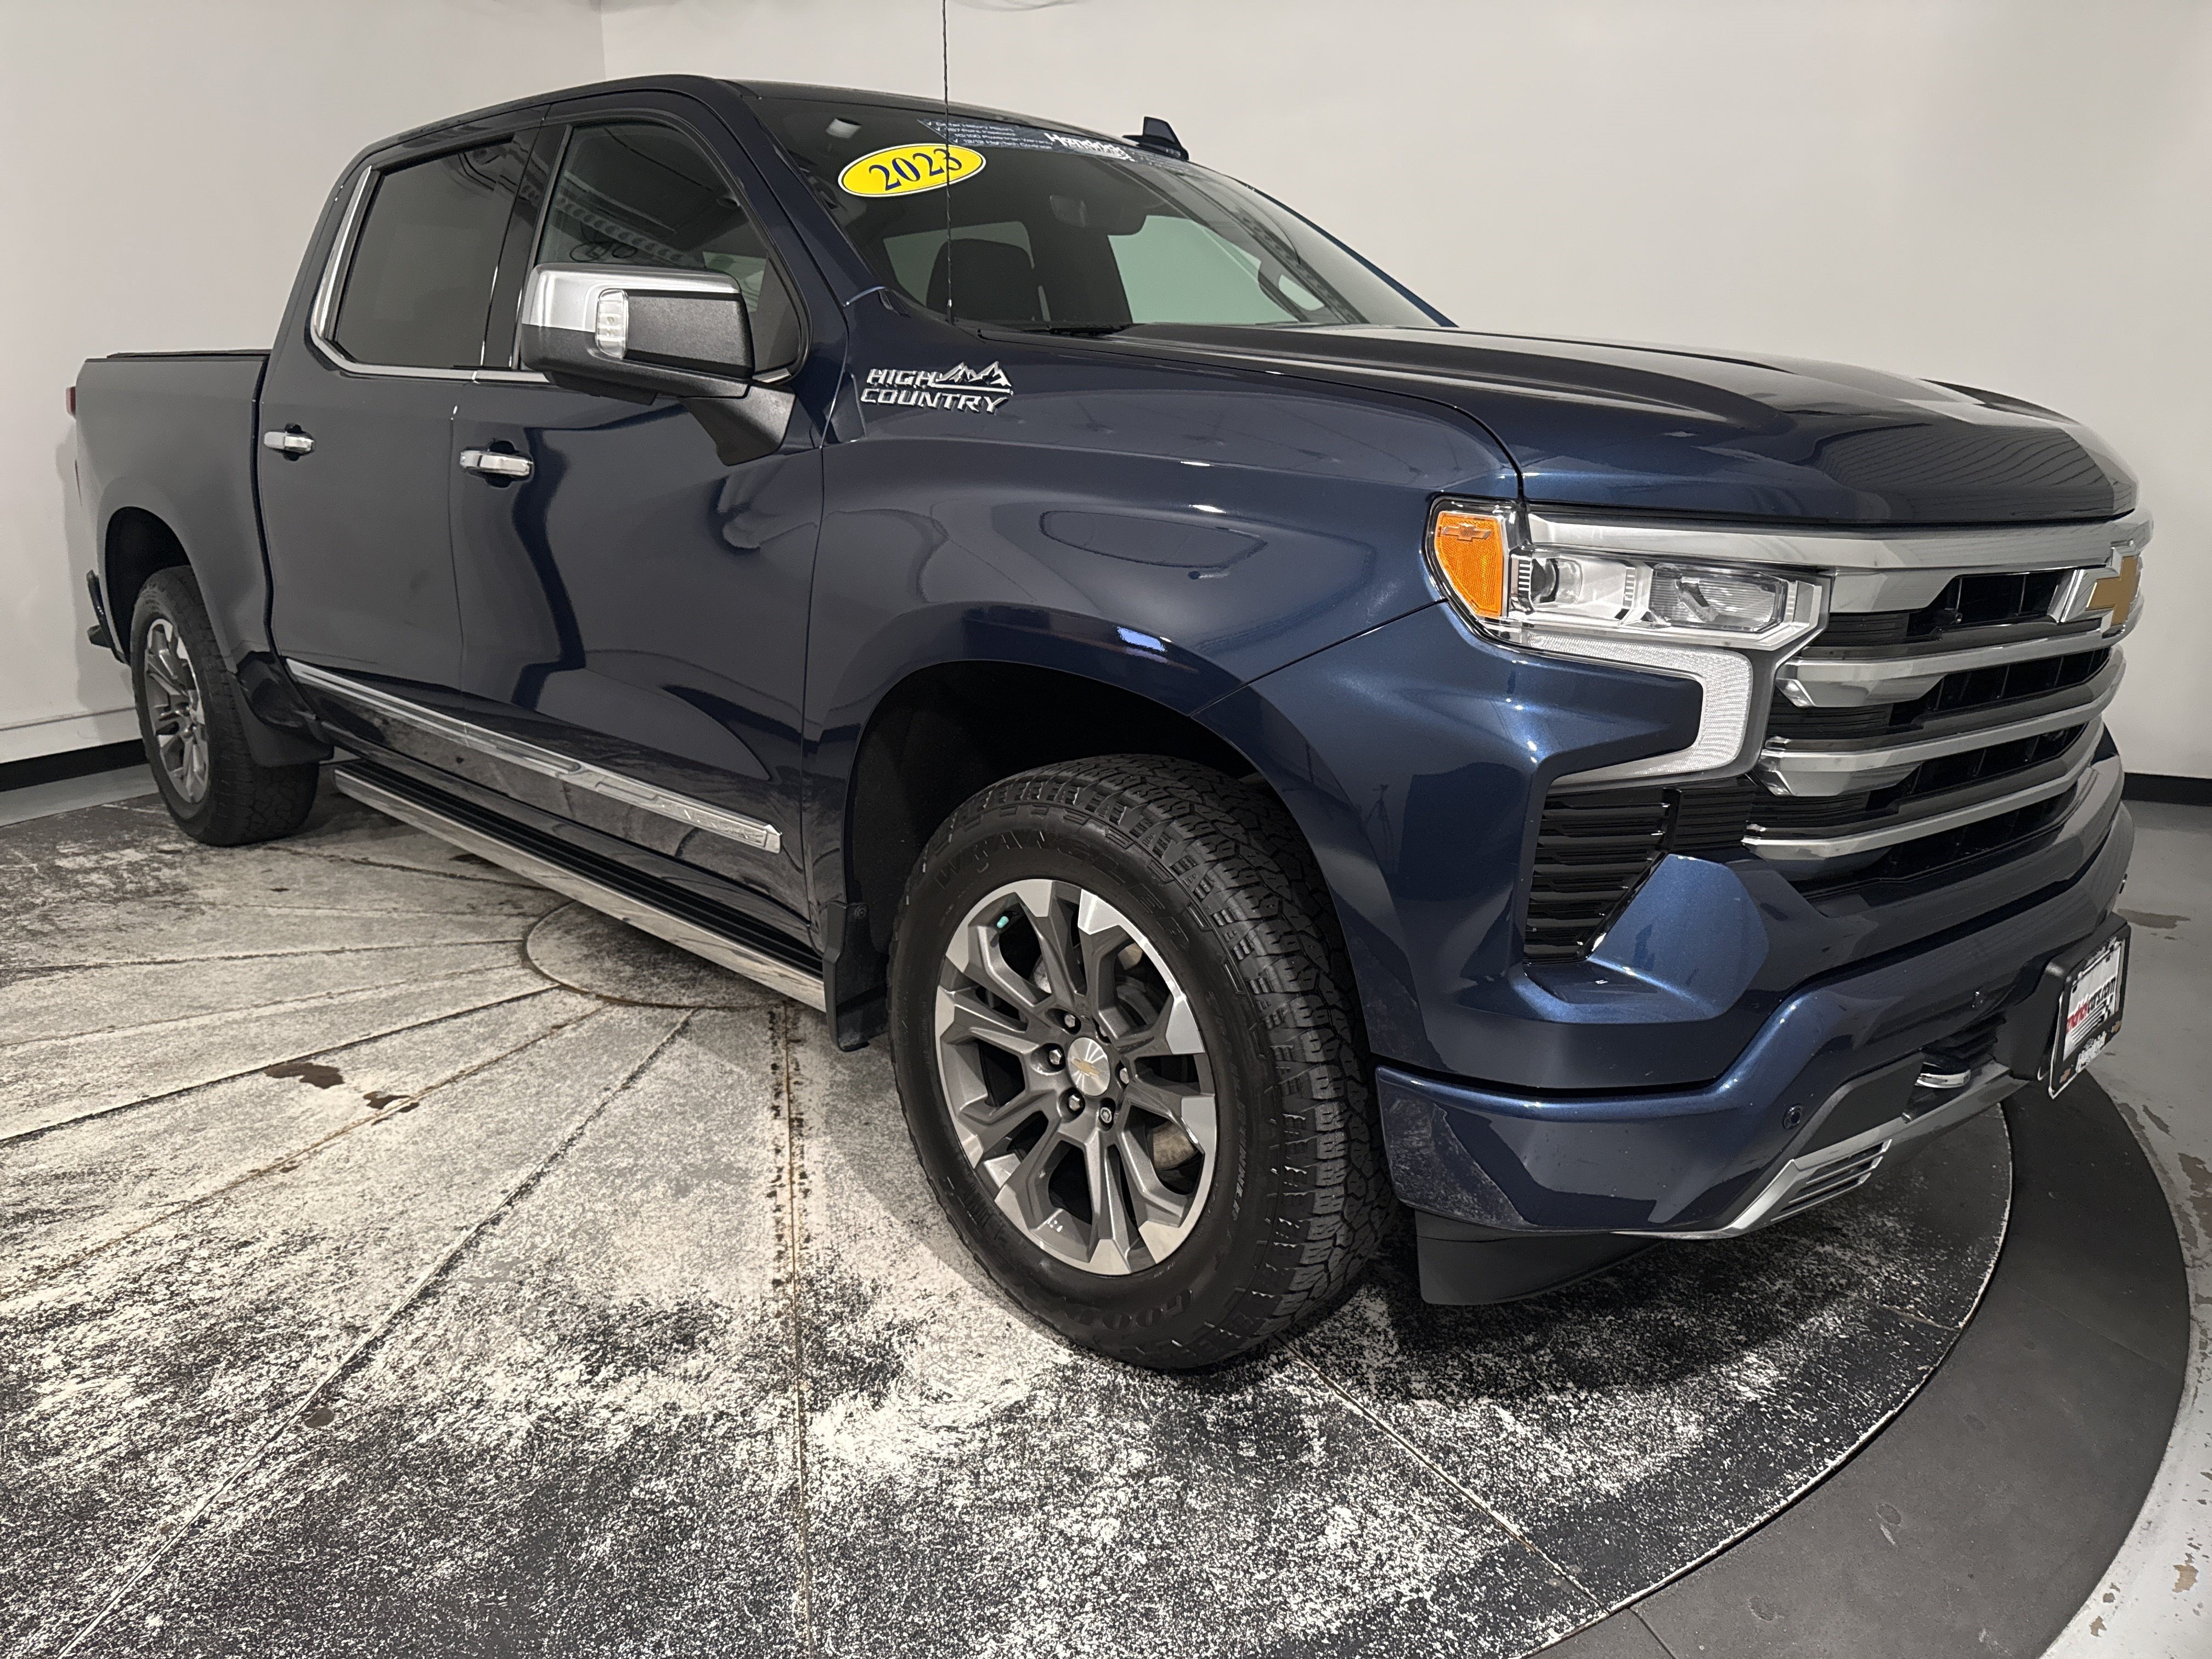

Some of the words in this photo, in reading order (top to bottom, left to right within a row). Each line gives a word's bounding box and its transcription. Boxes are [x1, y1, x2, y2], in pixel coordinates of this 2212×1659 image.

[868, 148, 962, 191] 2023
[866, 368, 941, 387] HIGH
[860, 387, 1009, 415] COUNTRY
